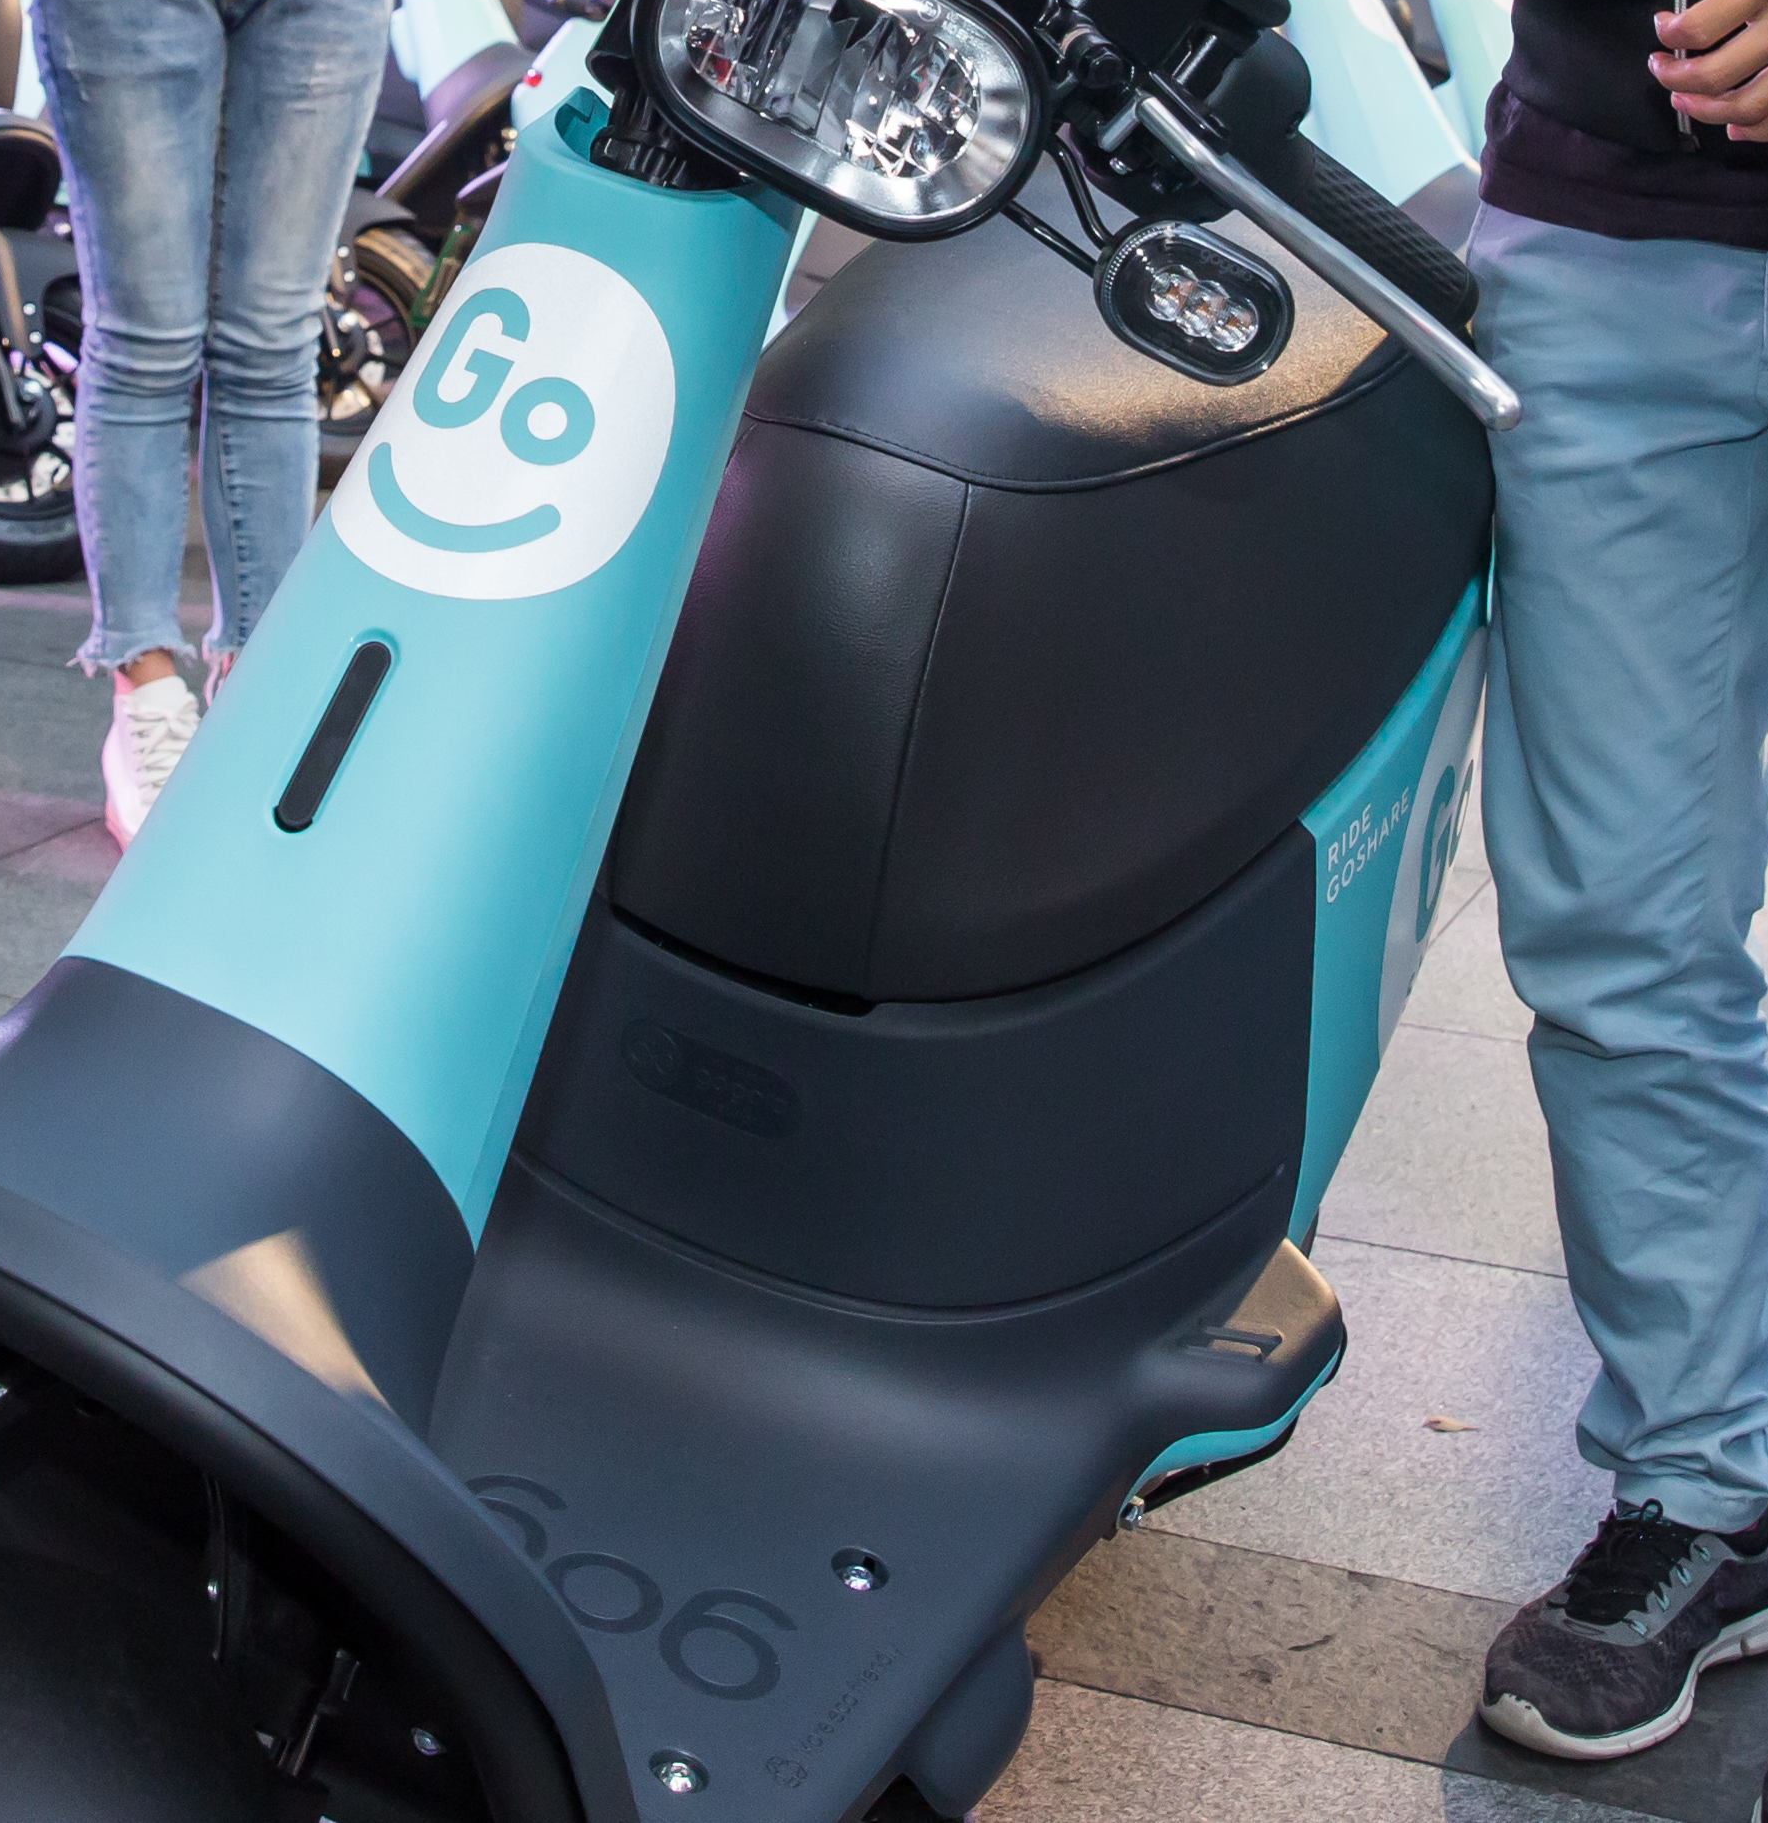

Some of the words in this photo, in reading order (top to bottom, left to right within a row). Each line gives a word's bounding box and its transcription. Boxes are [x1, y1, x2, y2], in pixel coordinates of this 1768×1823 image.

[412, 287, 596, 466] Go
[1326, 786, 1411, 904] GOSHARE
[1327, 802, 1373, 873] RIDE
